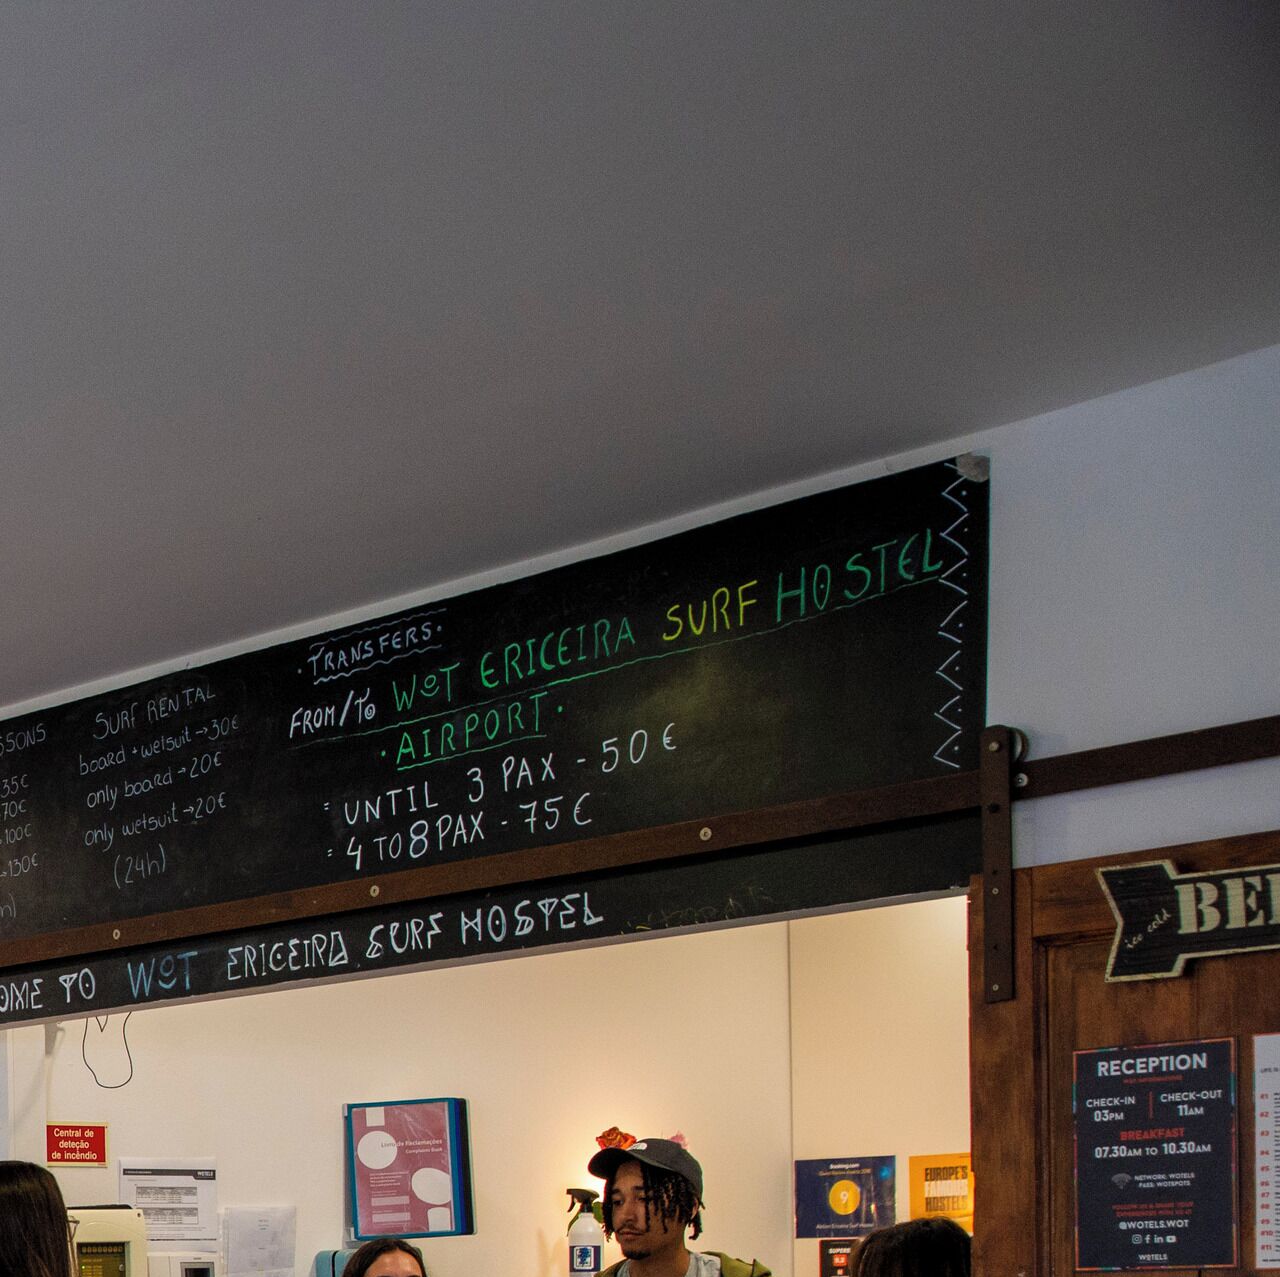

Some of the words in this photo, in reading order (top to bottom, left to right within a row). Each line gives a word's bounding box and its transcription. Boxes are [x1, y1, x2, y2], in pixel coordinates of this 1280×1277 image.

[480, 617, 637, 689] ERICEIRA
[661, 580, 759, 641] SURF
[776, 528, 944, 622] HOSTEL
[93, 702, 139, 740] SURF
[147, 684, 217, 723] RENTAL
[396, 691, 548, 764] AIRPORT
[79, 744, 127, 776] board
[208, 714, 240, 741] 30€
[0, 774, 29, 799] 35€
[86, 784, 118, 811] only
[124, 766, 173, 797] board
[190, 751, 222, 779] 20€
[345, 781, 439, 825] UNTIL
[466, 767, 484, 803] 3
[502, 752, 557, 792] PAX
[1, 800, 27, 822] 70€
[84, 823, 114, 853] only
[122, 801, 180, 836] wetsuit
[195, 791, 227, 819] 20€
[5, 823, 32, 845] 100€
[346, 836, 362, 870] 4
[373, 833, 402, 861] TO
[409, 820, 429, 859] 8
[436, 811, 485, 851] PAX
[8, 852, 39, 878] 130€
[113, 843, 166, 890] (24h)
[58, 968, 97, 1003] TO
[226, 930, 348, 982] ERICEIRA
[365, 911, 445, 959] SURF
[460, 891, 606, 946] HOSTEL
[1097, 1052, 1208, 1077] RECEPTION
[1086, 1096, 1136, 1108] CHECK-IN
[1160, 1089, 1223, 1103] CHECK-OUT
[54, 1128, 81, 1137] Central
[84, 1129, 94, 1138] de
[59, 1140, 89, 1150] deteção
[1120, 1127, 1185, 1141] BREAKFAST
[51, 1151, 61, 1159] de
[64, 1151, 97, 1160] incêndio
[925, 1165, 968, 1182] EUROPE'S
[840, 1191, 849, 1205] 9
